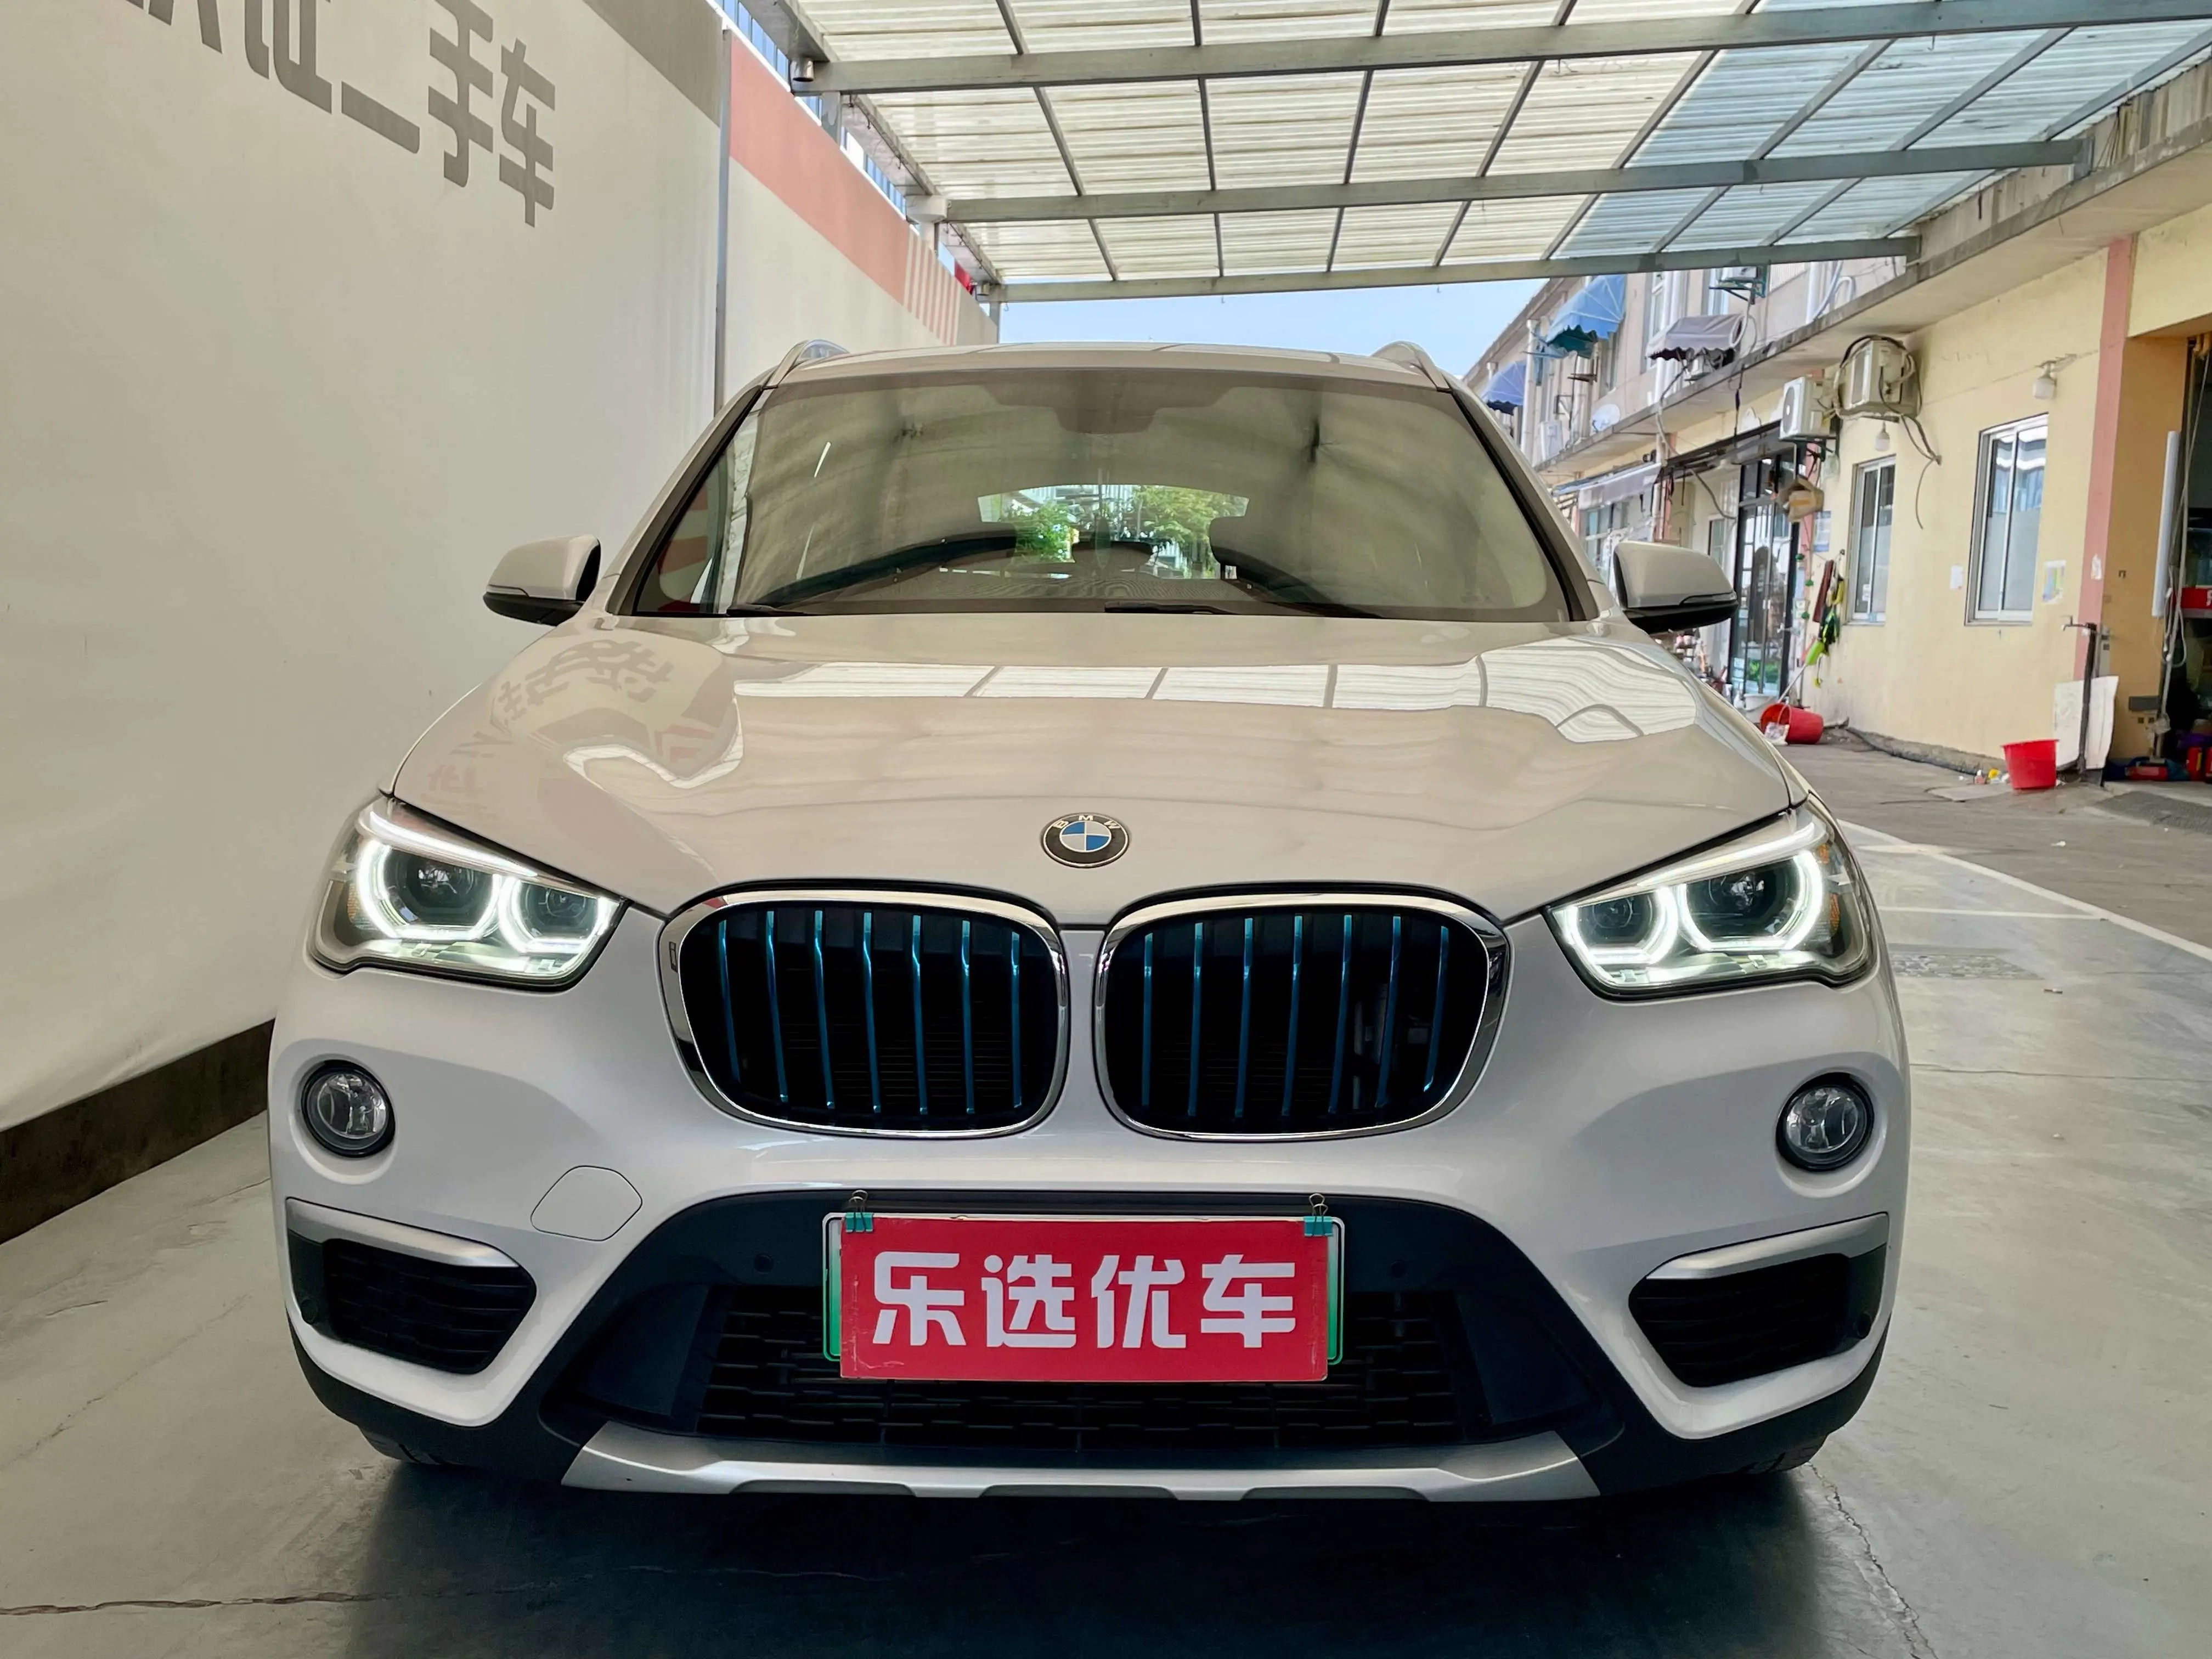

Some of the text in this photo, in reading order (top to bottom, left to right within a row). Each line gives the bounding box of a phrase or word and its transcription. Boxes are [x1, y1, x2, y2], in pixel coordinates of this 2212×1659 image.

[1053, 814, 1120, 830] BMW
[872, 1251, 1296, 1348] 乐选优车
